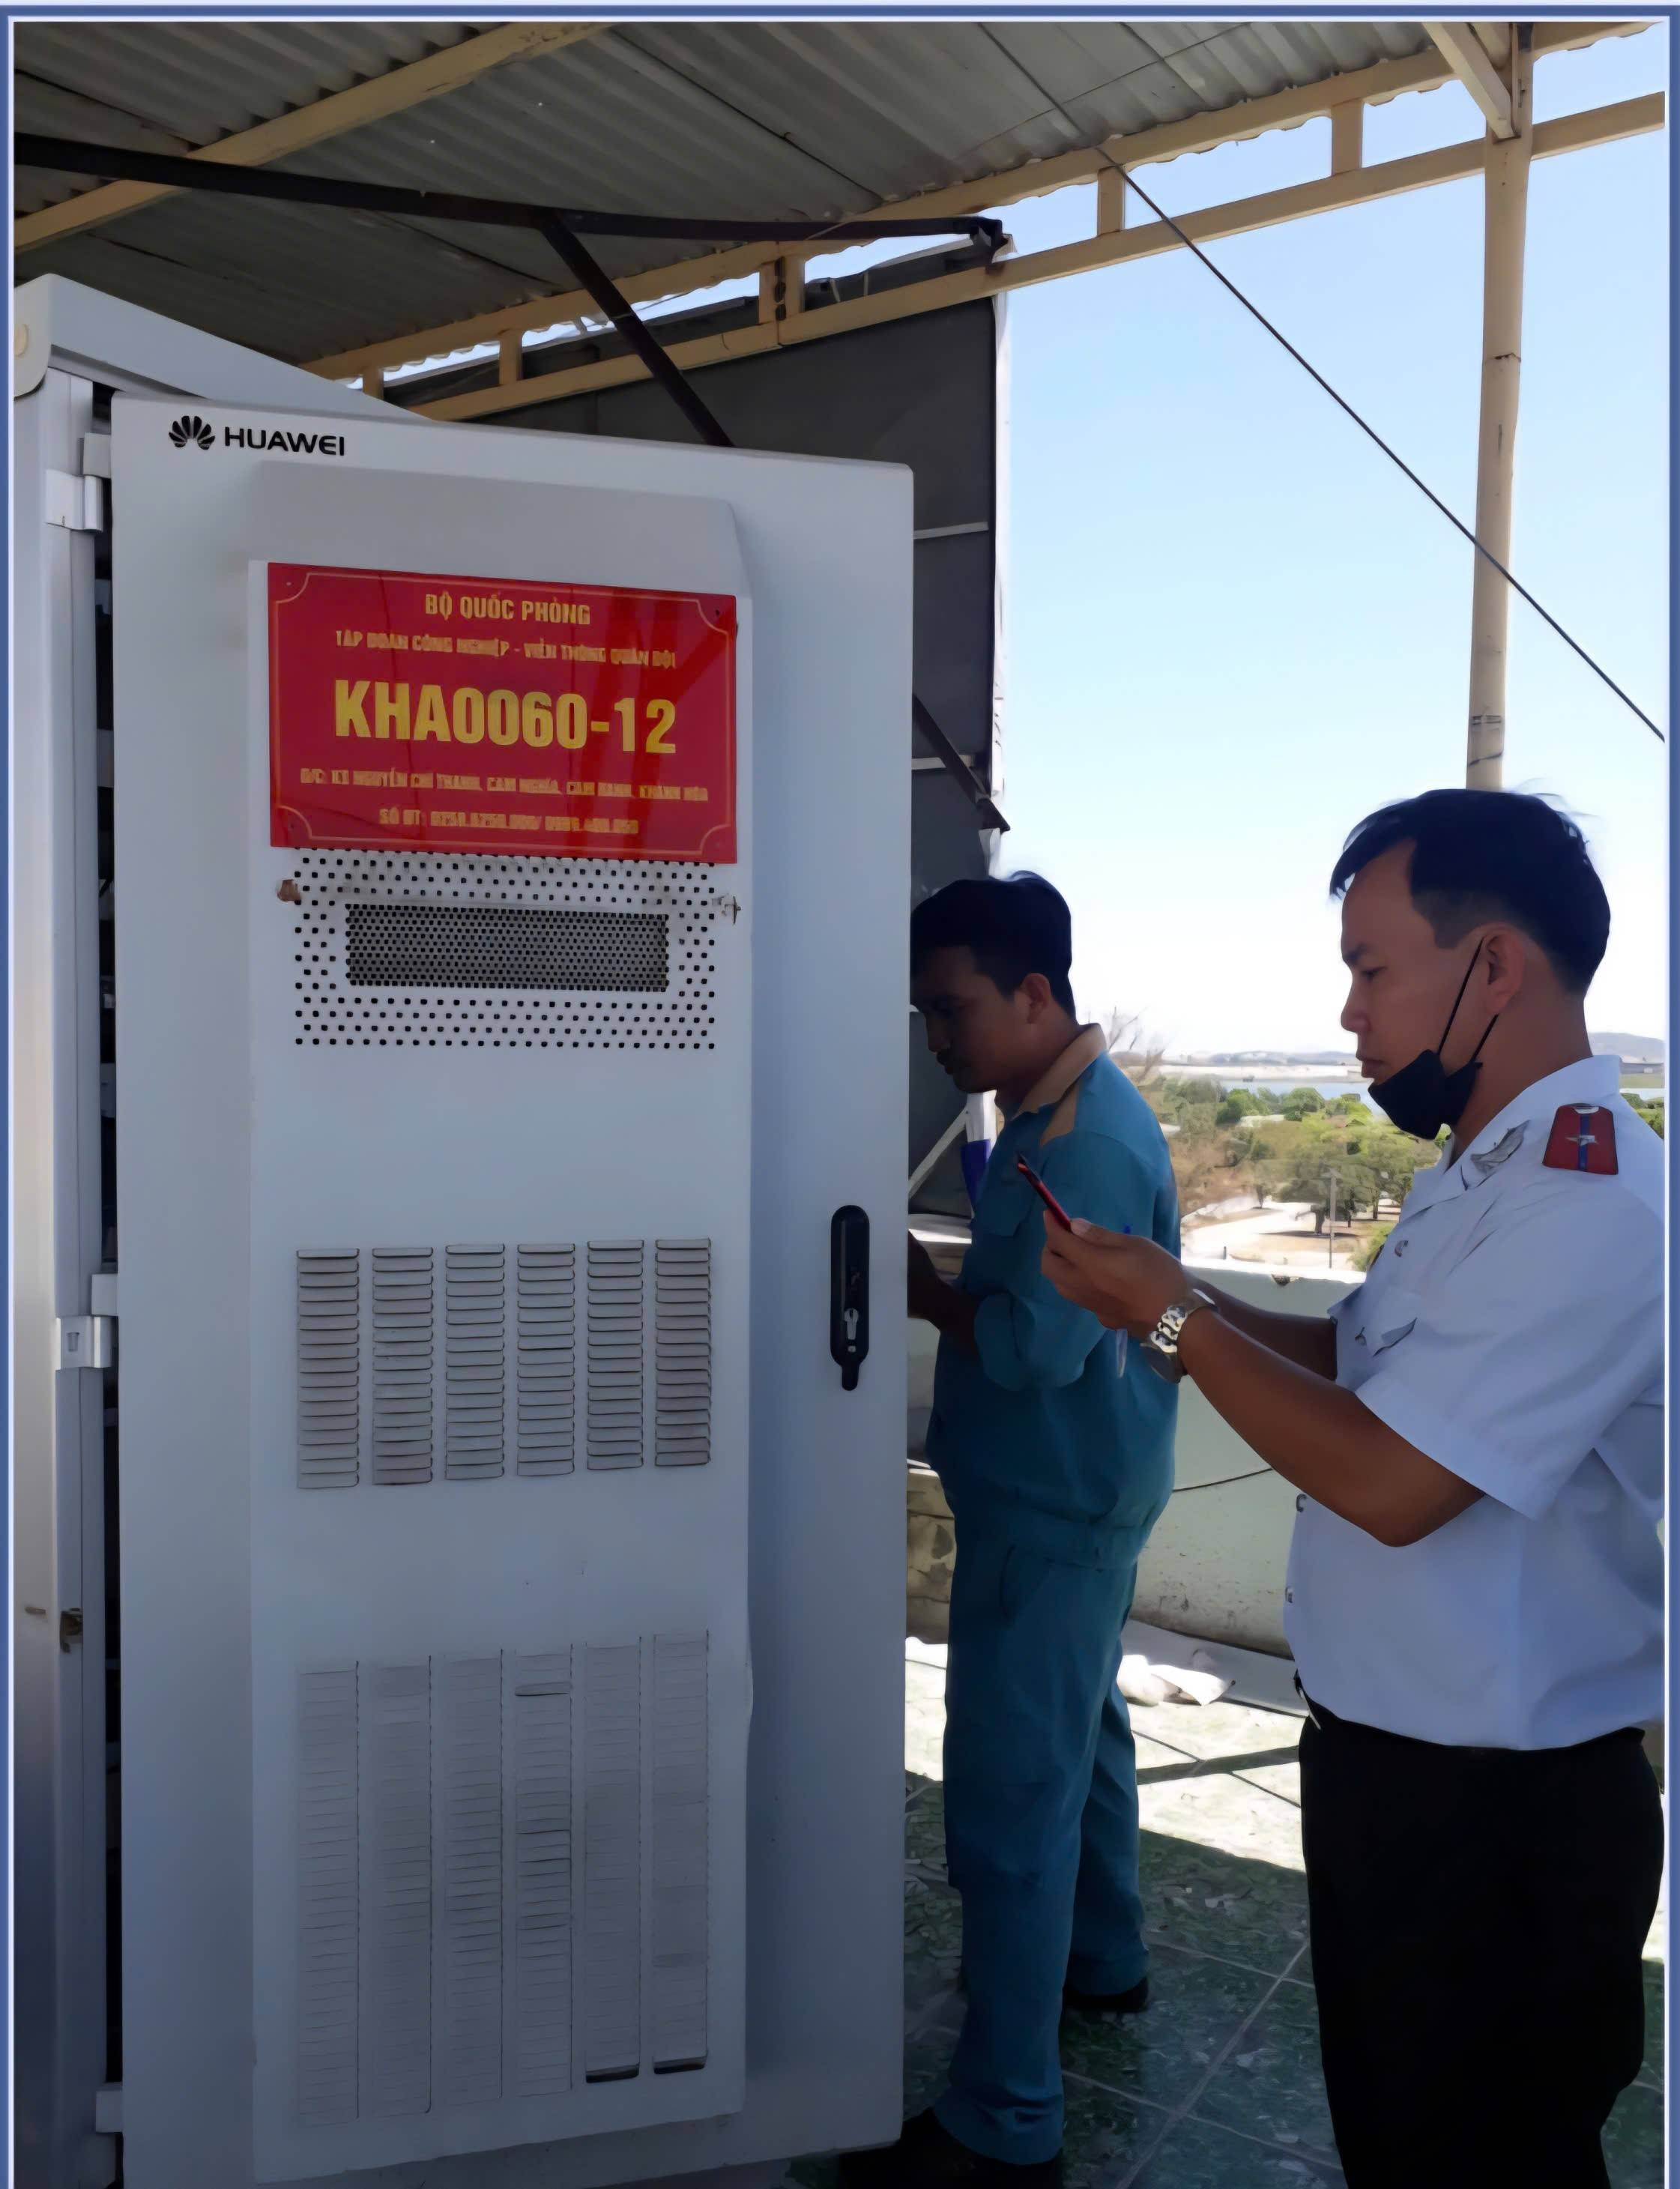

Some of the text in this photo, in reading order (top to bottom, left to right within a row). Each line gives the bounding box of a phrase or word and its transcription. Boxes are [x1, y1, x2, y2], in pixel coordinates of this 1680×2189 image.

[225, 426, 345, 456] HUAWEI
[425, 591, 590, 625] BỘ QUỐC PHÒNG
[335, 679, 676, 754] KHA0060-12
